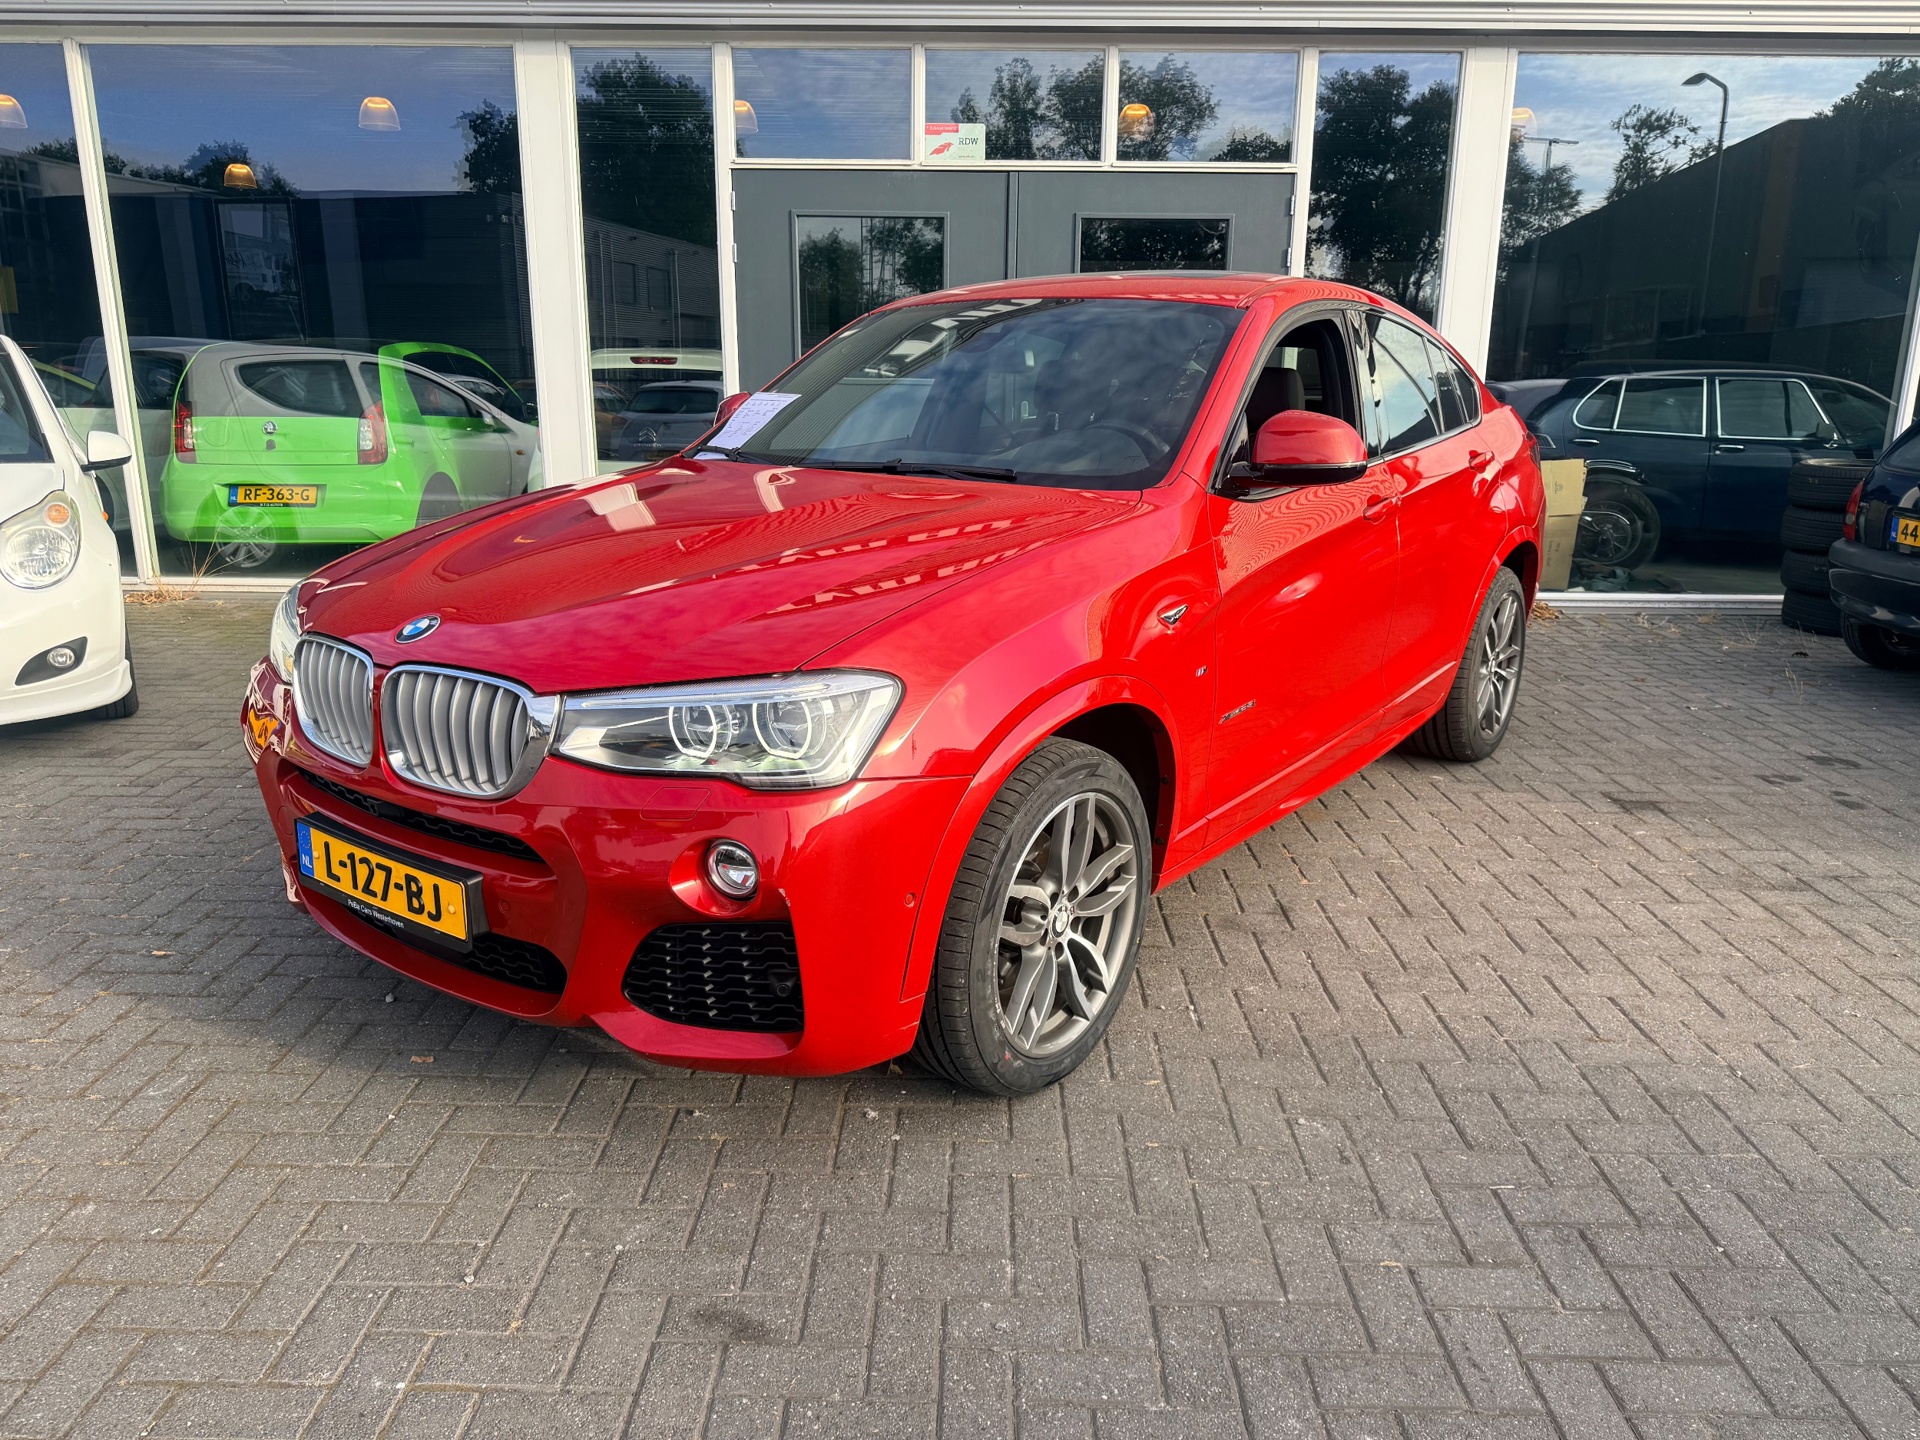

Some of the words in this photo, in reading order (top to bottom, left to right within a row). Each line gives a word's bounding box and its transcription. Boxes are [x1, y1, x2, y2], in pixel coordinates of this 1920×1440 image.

[958, 137, 979, 146] RDW
[243, 488, 310, 501] RF-363-G
[1901, 523, 1919, 543] 44
[302, 853, 313, 869] NL
[323, 841, 442, 922] L-127-BJ
[360, 904, 373, 915] Cars
[372, 908, 405, 929] Westerhoven
